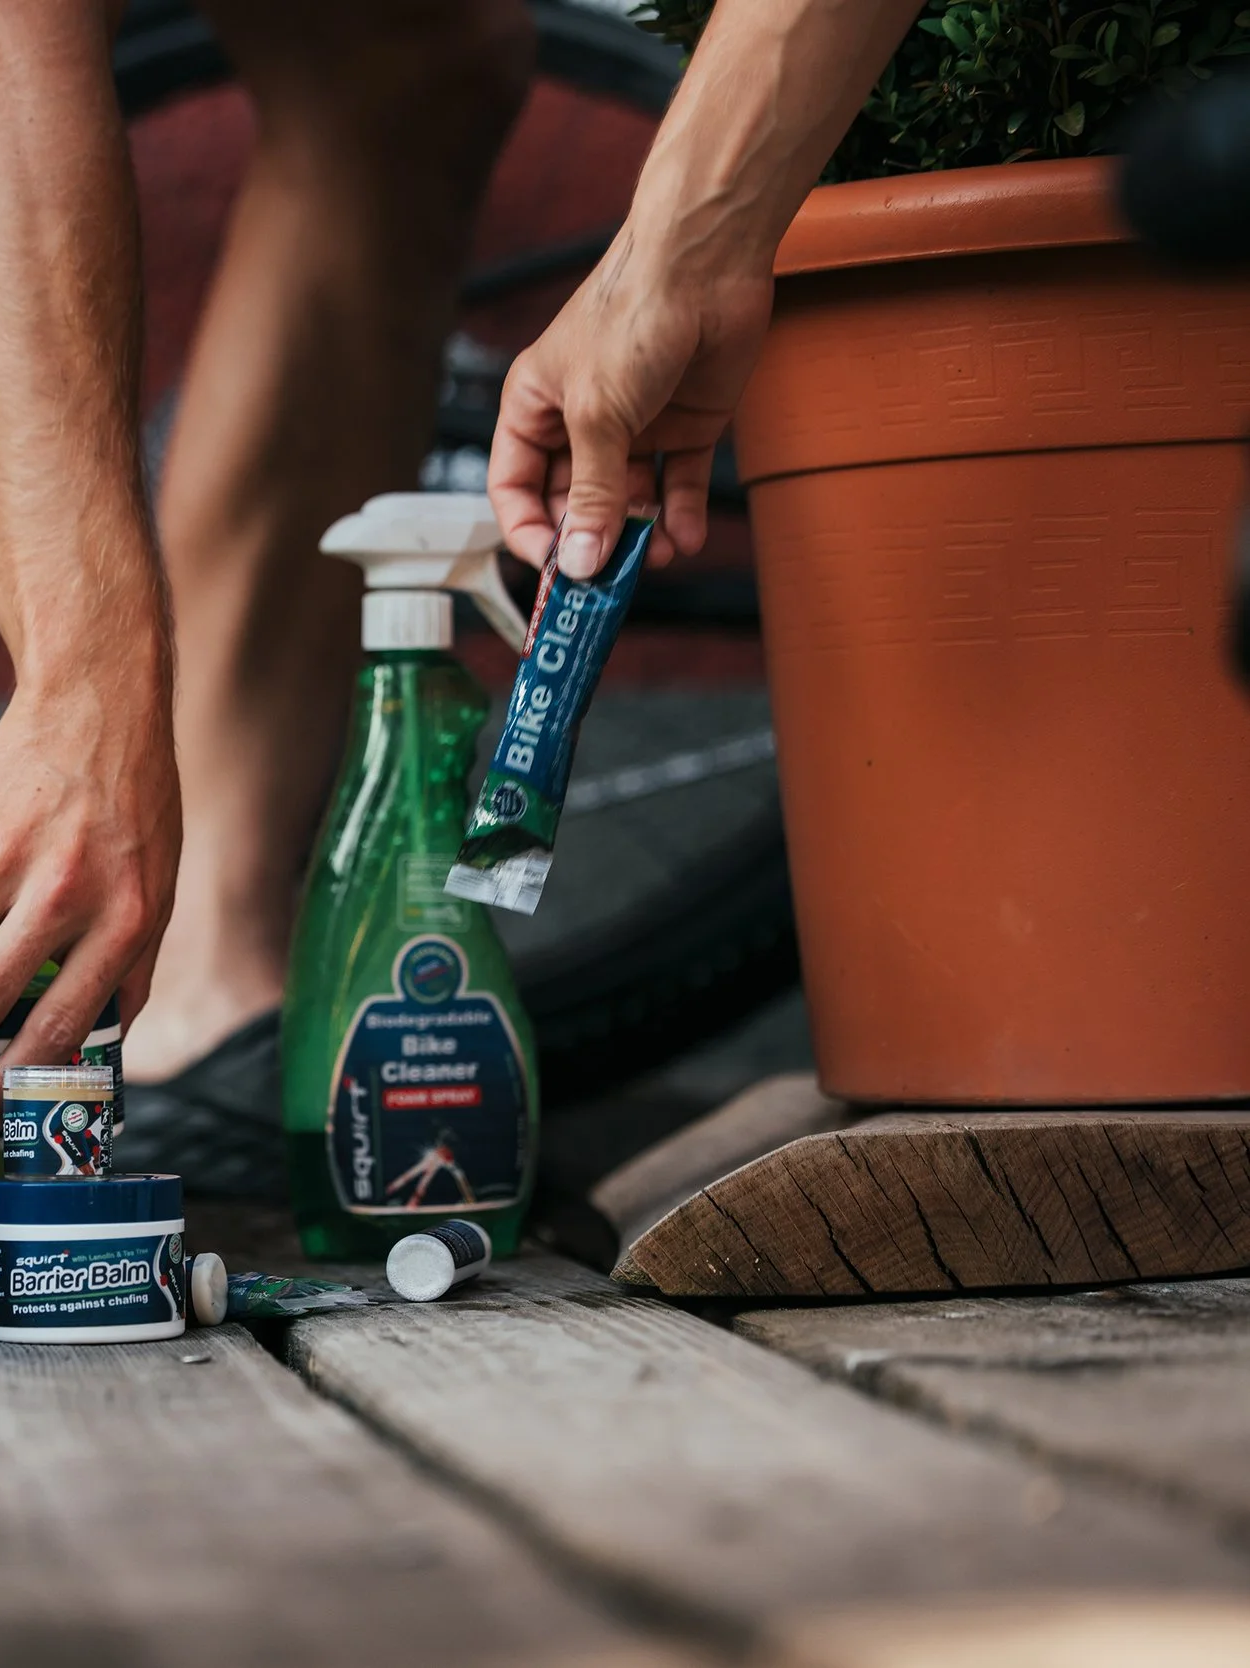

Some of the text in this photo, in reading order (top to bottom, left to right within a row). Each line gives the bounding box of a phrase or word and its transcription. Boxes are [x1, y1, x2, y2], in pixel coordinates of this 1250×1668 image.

[505, 684, 553, 775] Bike
[365, 1011, 492, 1030] Biodegradable
[401, 1034, 457, 1056] Bike
[381, 1060, 479, 1082] Cleaner
[3, 1119, 38, 1141] Balm
[349, 1080, 375, 1199] squirt
[9, 1149, 35, 1159] chafing
[61, 1130, 82, 1158] squirt
[16, 1252, 70, 1268] squirt
[10, 1267, 87, 1296] Barrier
[88, 1260, 150, 1290] Balm
[12, 1303, 57, 1315] Protects
[60, 1300, 106, 1313] against
[108, 1294, 149, 1307] chafing
